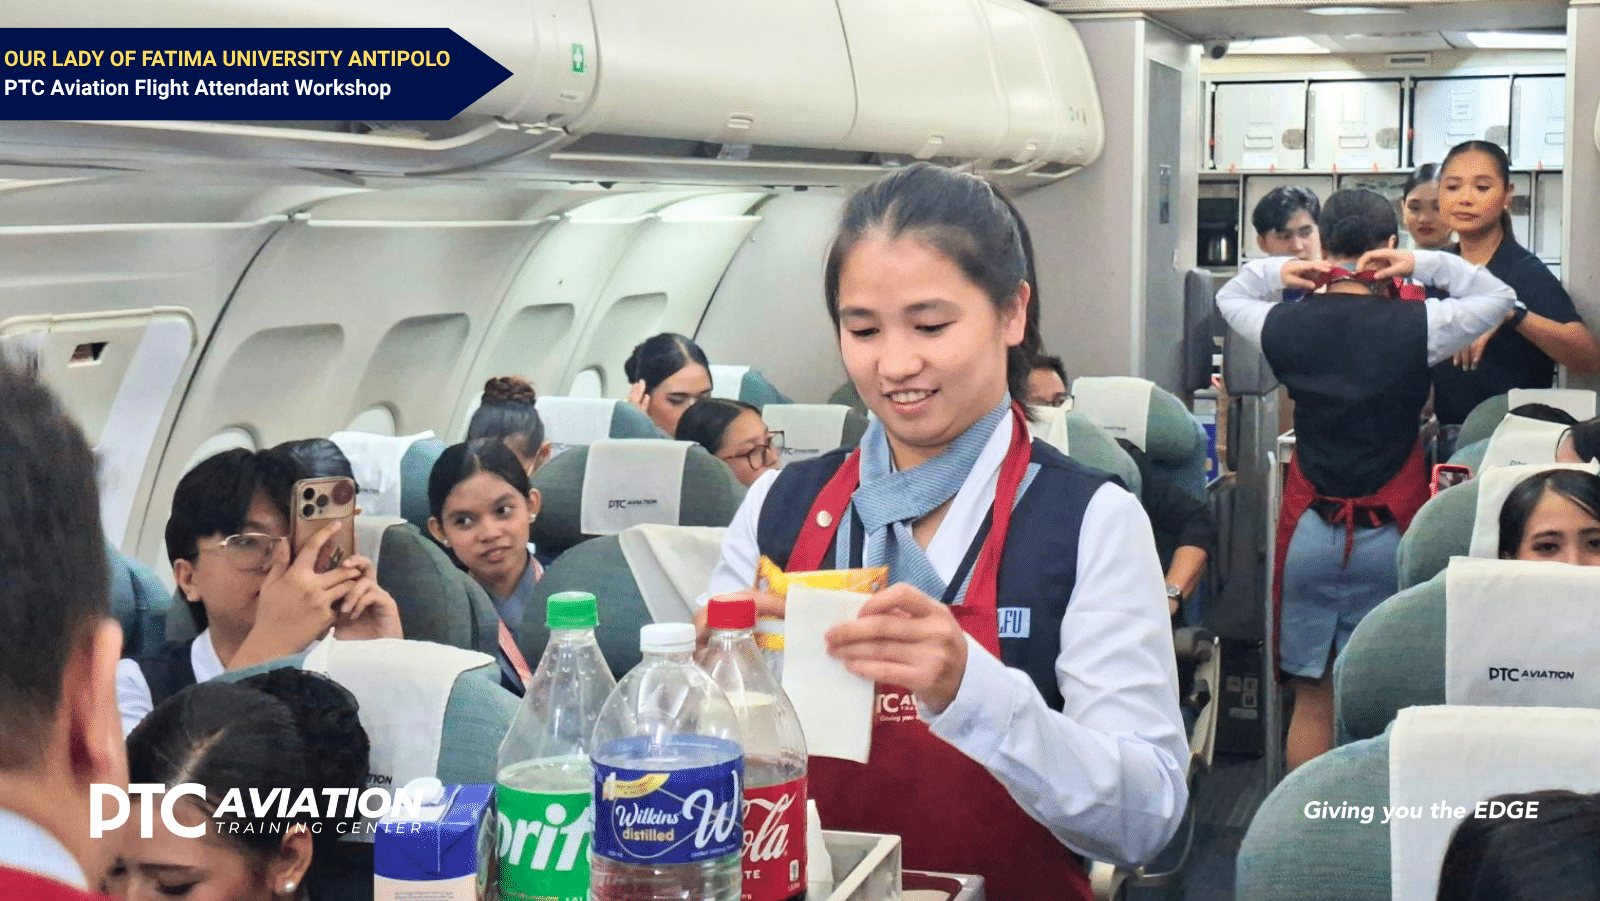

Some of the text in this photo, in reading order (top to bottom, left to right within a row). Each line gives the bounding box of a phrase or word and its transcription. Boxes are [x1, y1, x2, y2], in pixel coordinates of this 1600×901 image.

[1488, 666, 1575, 682] PTC AVIATION
[615, 802, 679, 827] Wilkins
[622, 827, 675, 842] distilled
